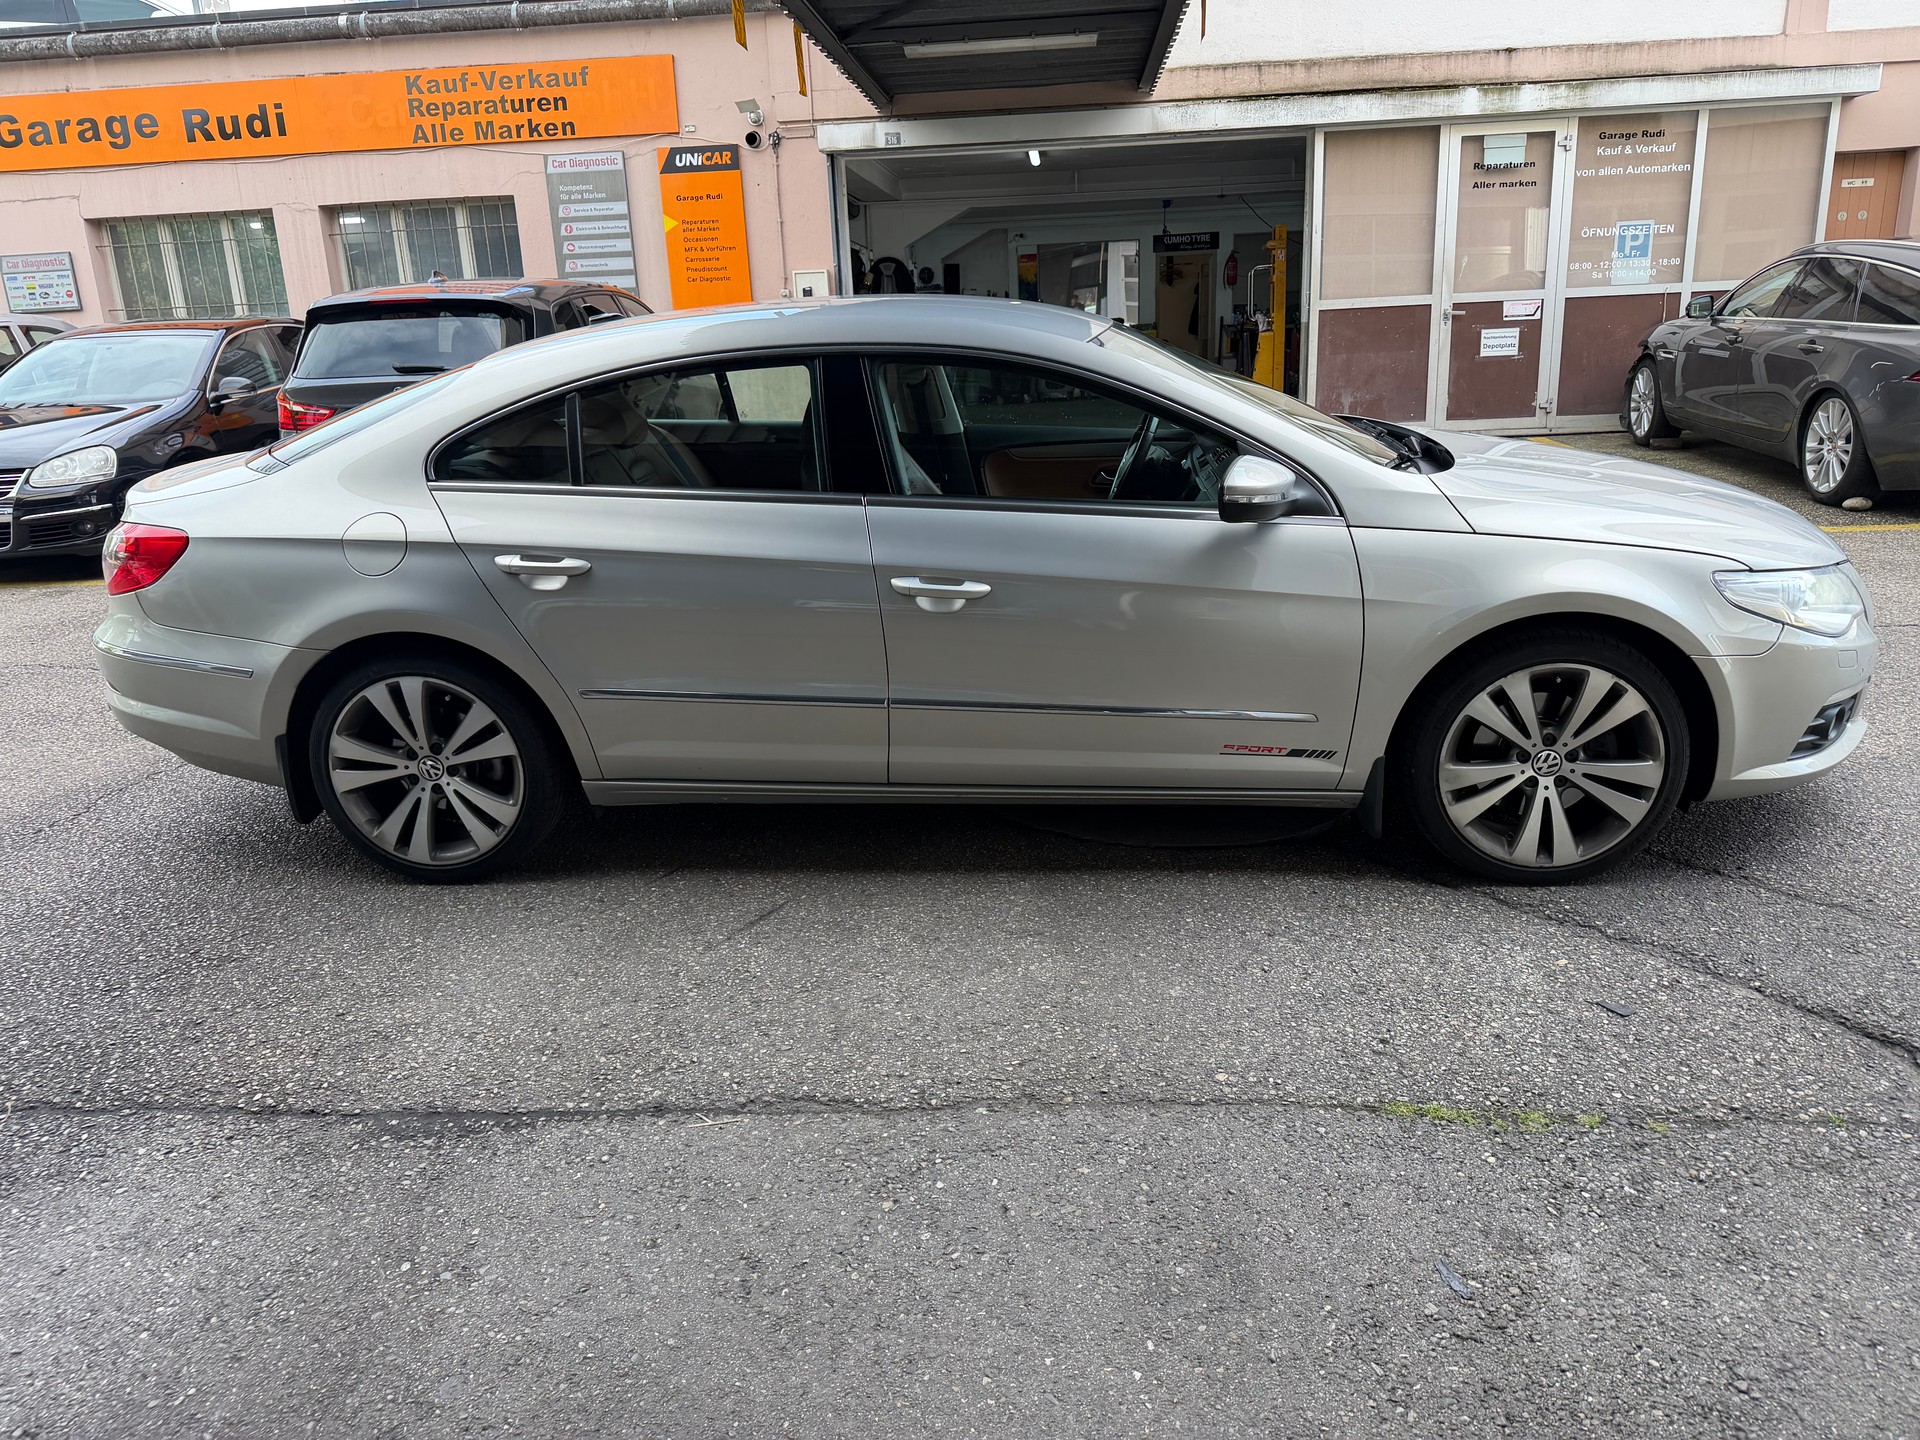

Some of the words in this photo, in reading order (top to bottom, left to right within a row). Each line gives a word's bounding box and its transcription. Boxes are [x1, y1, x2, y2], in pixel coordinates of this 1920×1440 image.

[404, 66, 590, 96] Kauf-Verkauf
[407, 94, 569, 122] Reparaturen
[0, 113, 160, 150] Garage
[181, 102, 288, 144] Rudi
[412, 123, 465, 145] Alle
[474, 118, 577, 141] Marken
[1598, 131, 1638, 140] Garage
[1642, 129, 1666, 138] Rudi
[1596, 145, 1622, 156] Kauf
[1624, 144, 1632, 154] &
[1636, 142, 1676, 154] Verkauf
[552, 159, 567, 169] Car
[569, 156, 618, 170] Diagnostic
[1474, 161, 1536, 172] Reparaturen
[1576, 169, 1596, 177] von
[1598, 166, 1624, 176] allen
[1626, 163, 1691, 174] Automarken
[560, 184, 593, 192] Kompetenz
[1472, 181, 1496, 190] Aller
[1499, 180, 1537, 188] marken
[1192, 234, 1211, 242] TYRE
[1625, 231, 1645, 256] P
[6, 260, 20, 269] Car
[21, 257, 66, 269] Diagnostic
[1223, 744, 1287, 753] SPORT
